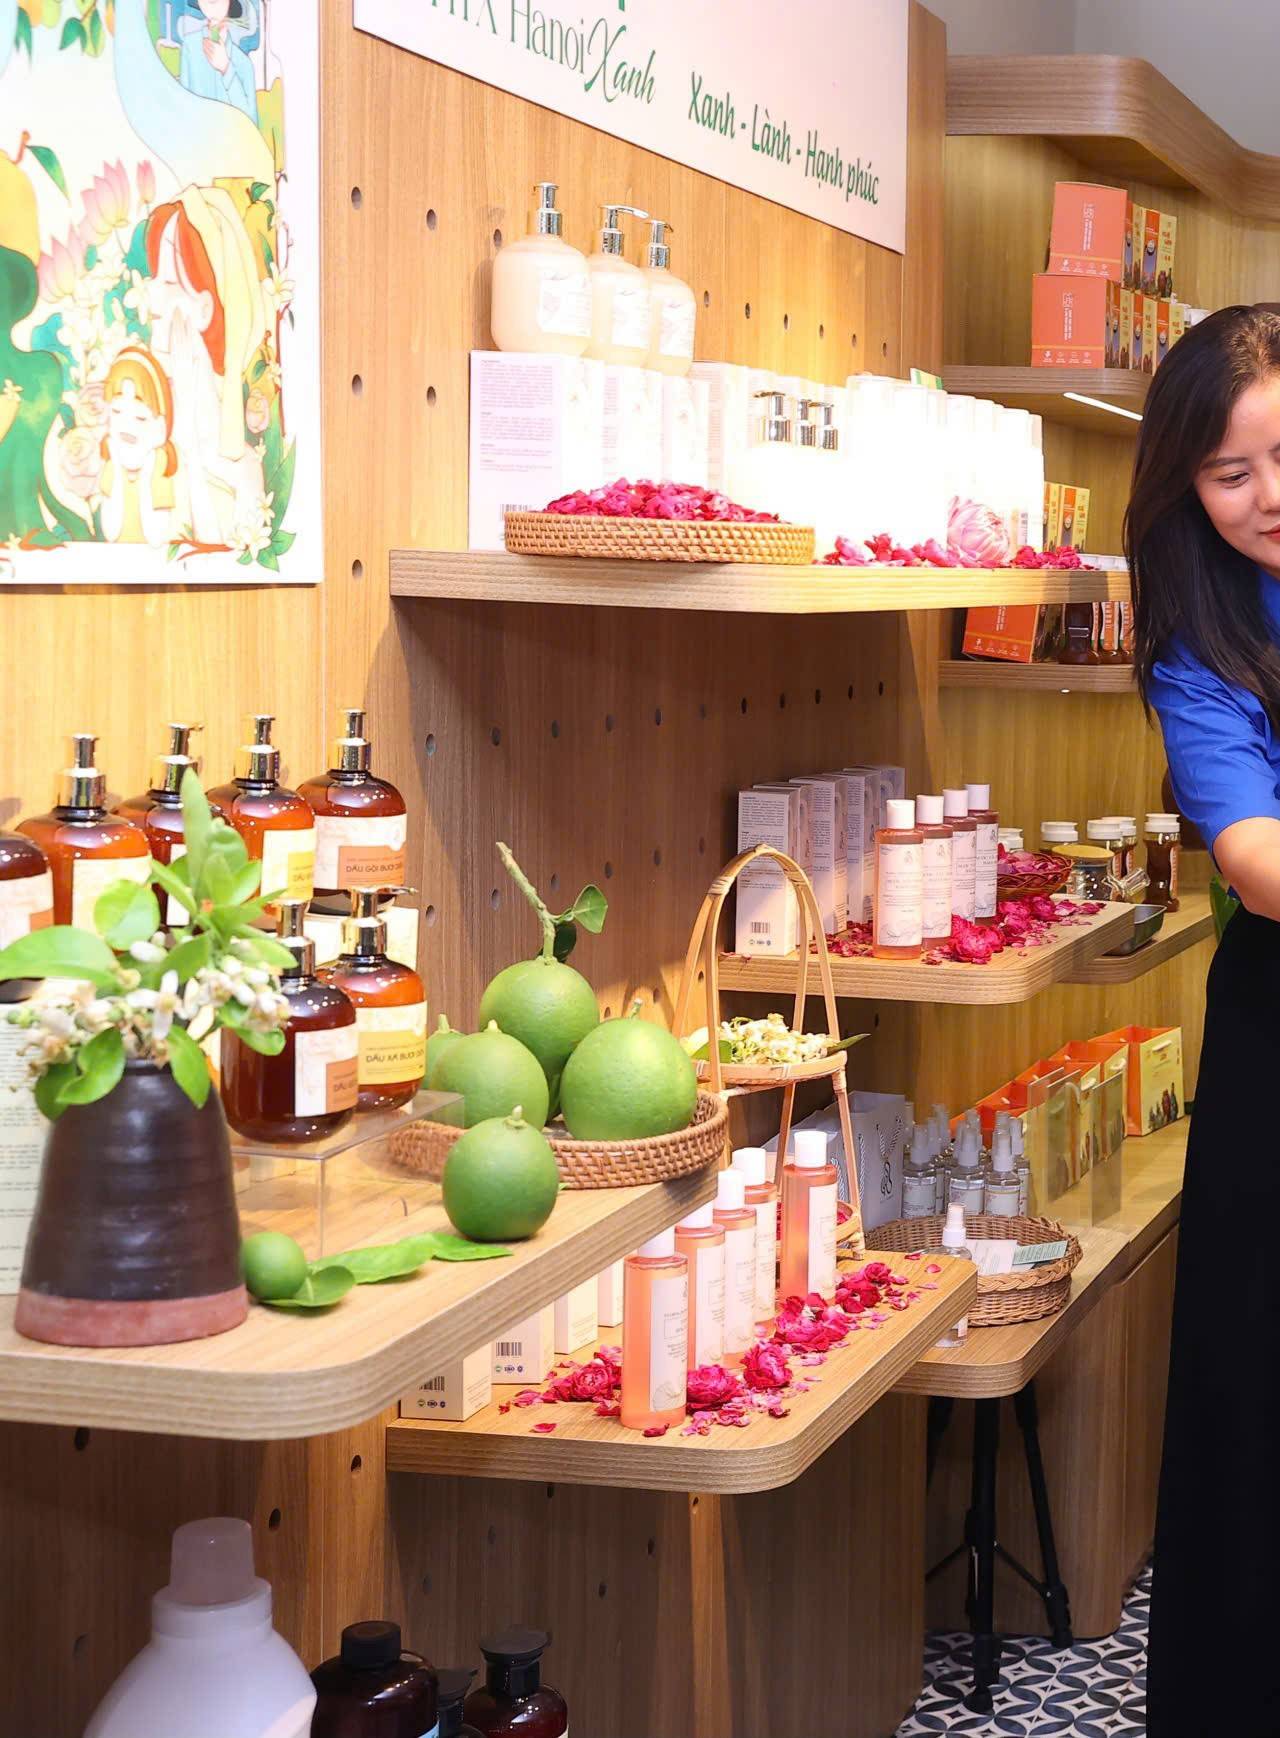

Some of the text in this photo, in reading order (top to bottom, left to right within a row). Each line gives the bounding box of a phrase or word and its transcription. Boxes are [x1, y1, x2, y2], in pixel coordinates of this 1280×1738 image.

[688, 71, 736, 139] Xanh
[752, 103, 791, 165] Lành
[804, 129, 843, 190] Hạnh
[846, 157, 879, 205] phúc
